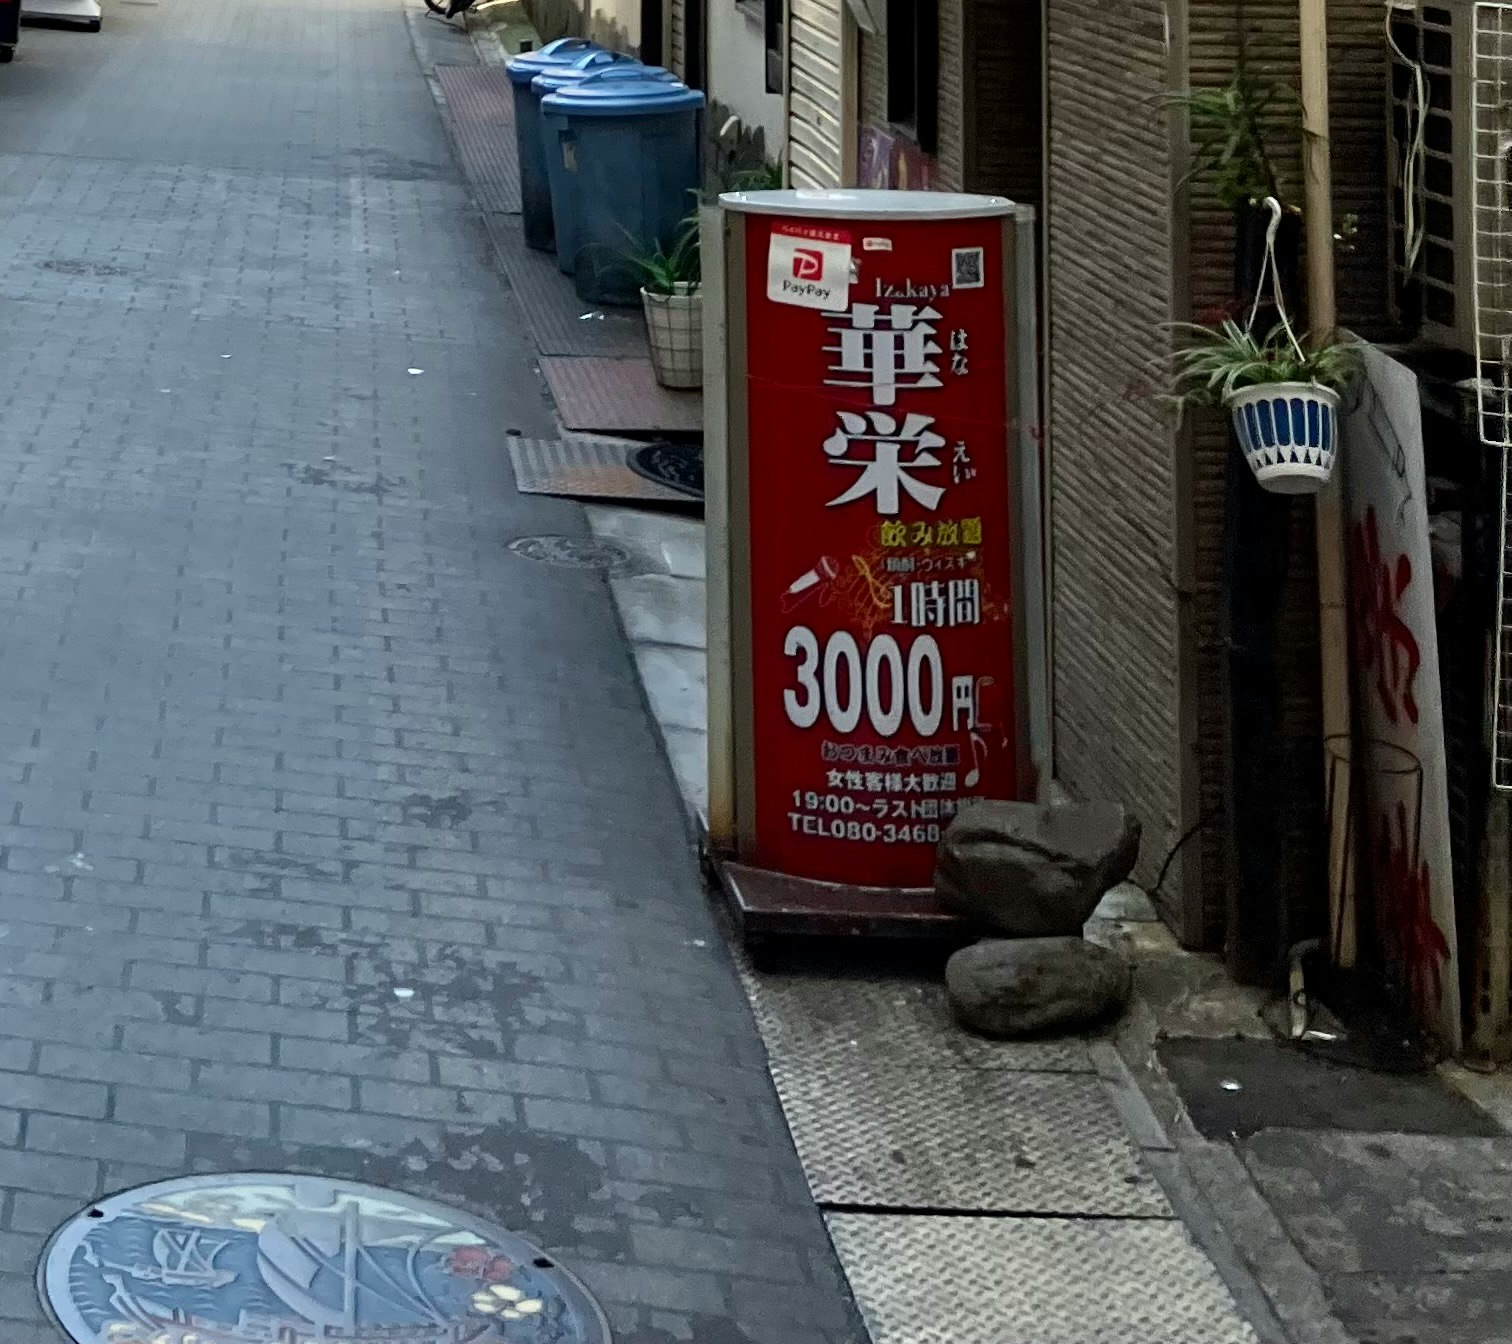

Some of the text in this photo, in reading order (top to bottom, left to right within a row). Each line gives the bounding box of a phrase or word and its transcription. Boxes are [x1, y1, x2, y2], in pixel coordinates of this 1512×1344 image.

[782, 279, 831, 301] PayPay
[875, 277, 950, 303] Izakaya
[950, 328, 968, 376] はな
[820, 303, 947, 515] 華栄
[880, 515, 983, 547] 飲み放題
[890, 578, 980, 627] 1時間
